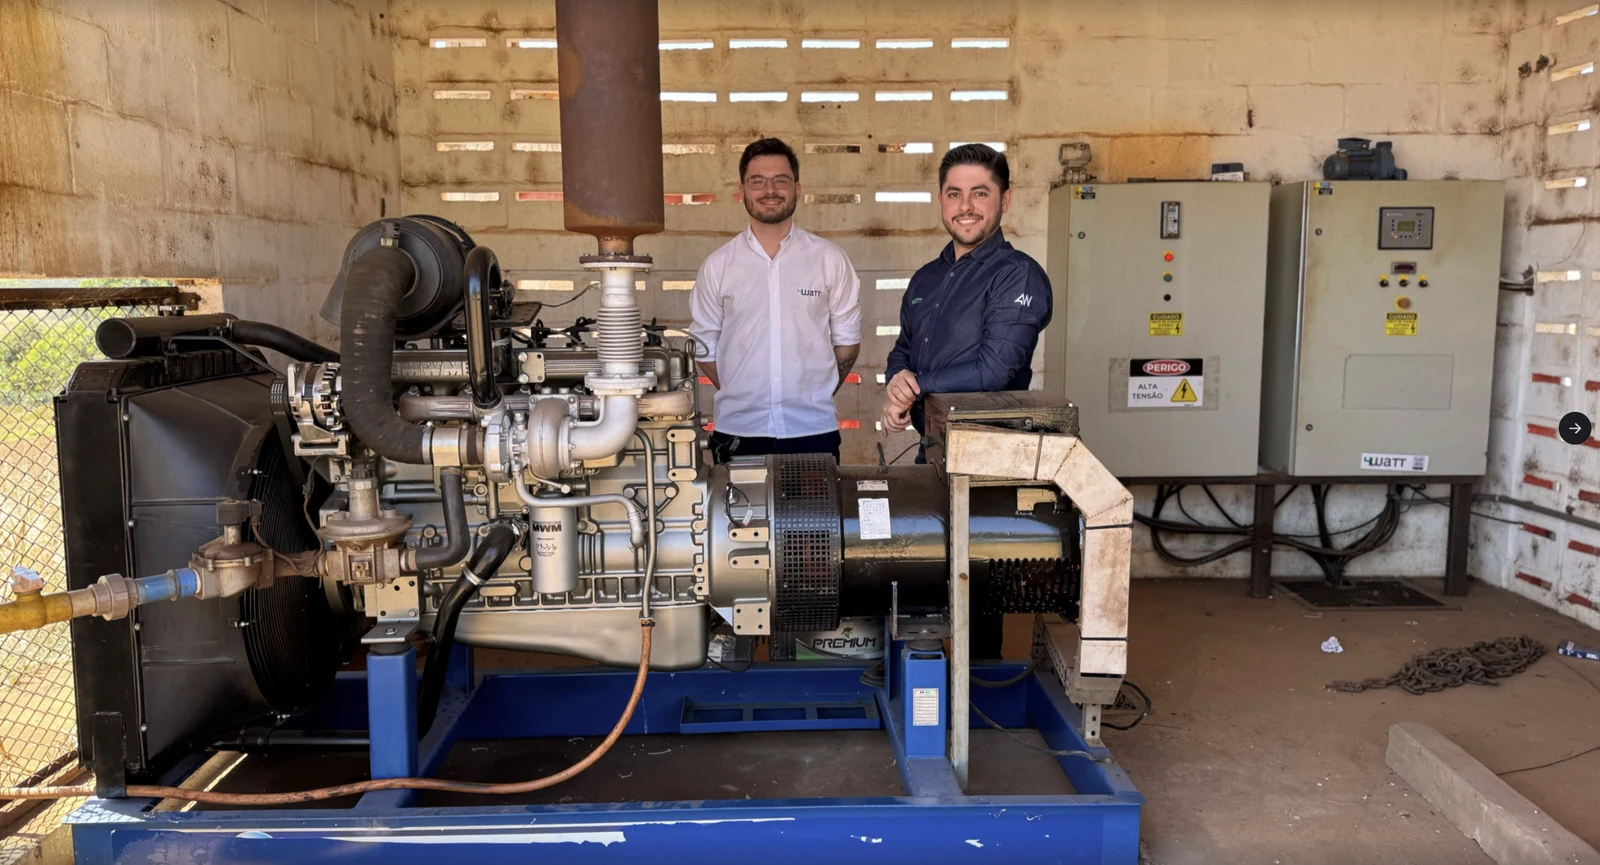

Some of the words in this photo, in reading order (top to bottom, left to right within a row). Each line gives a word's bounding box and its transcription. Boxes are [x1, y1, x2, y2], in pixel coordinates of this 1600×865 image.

[1147, 363, 1186, 372] PERIGO
[1132, 391, 1163, 399] TENSÃO
[532, 524, 562, 532] MWM
[812, 637, 877, 649] PREMIUM
